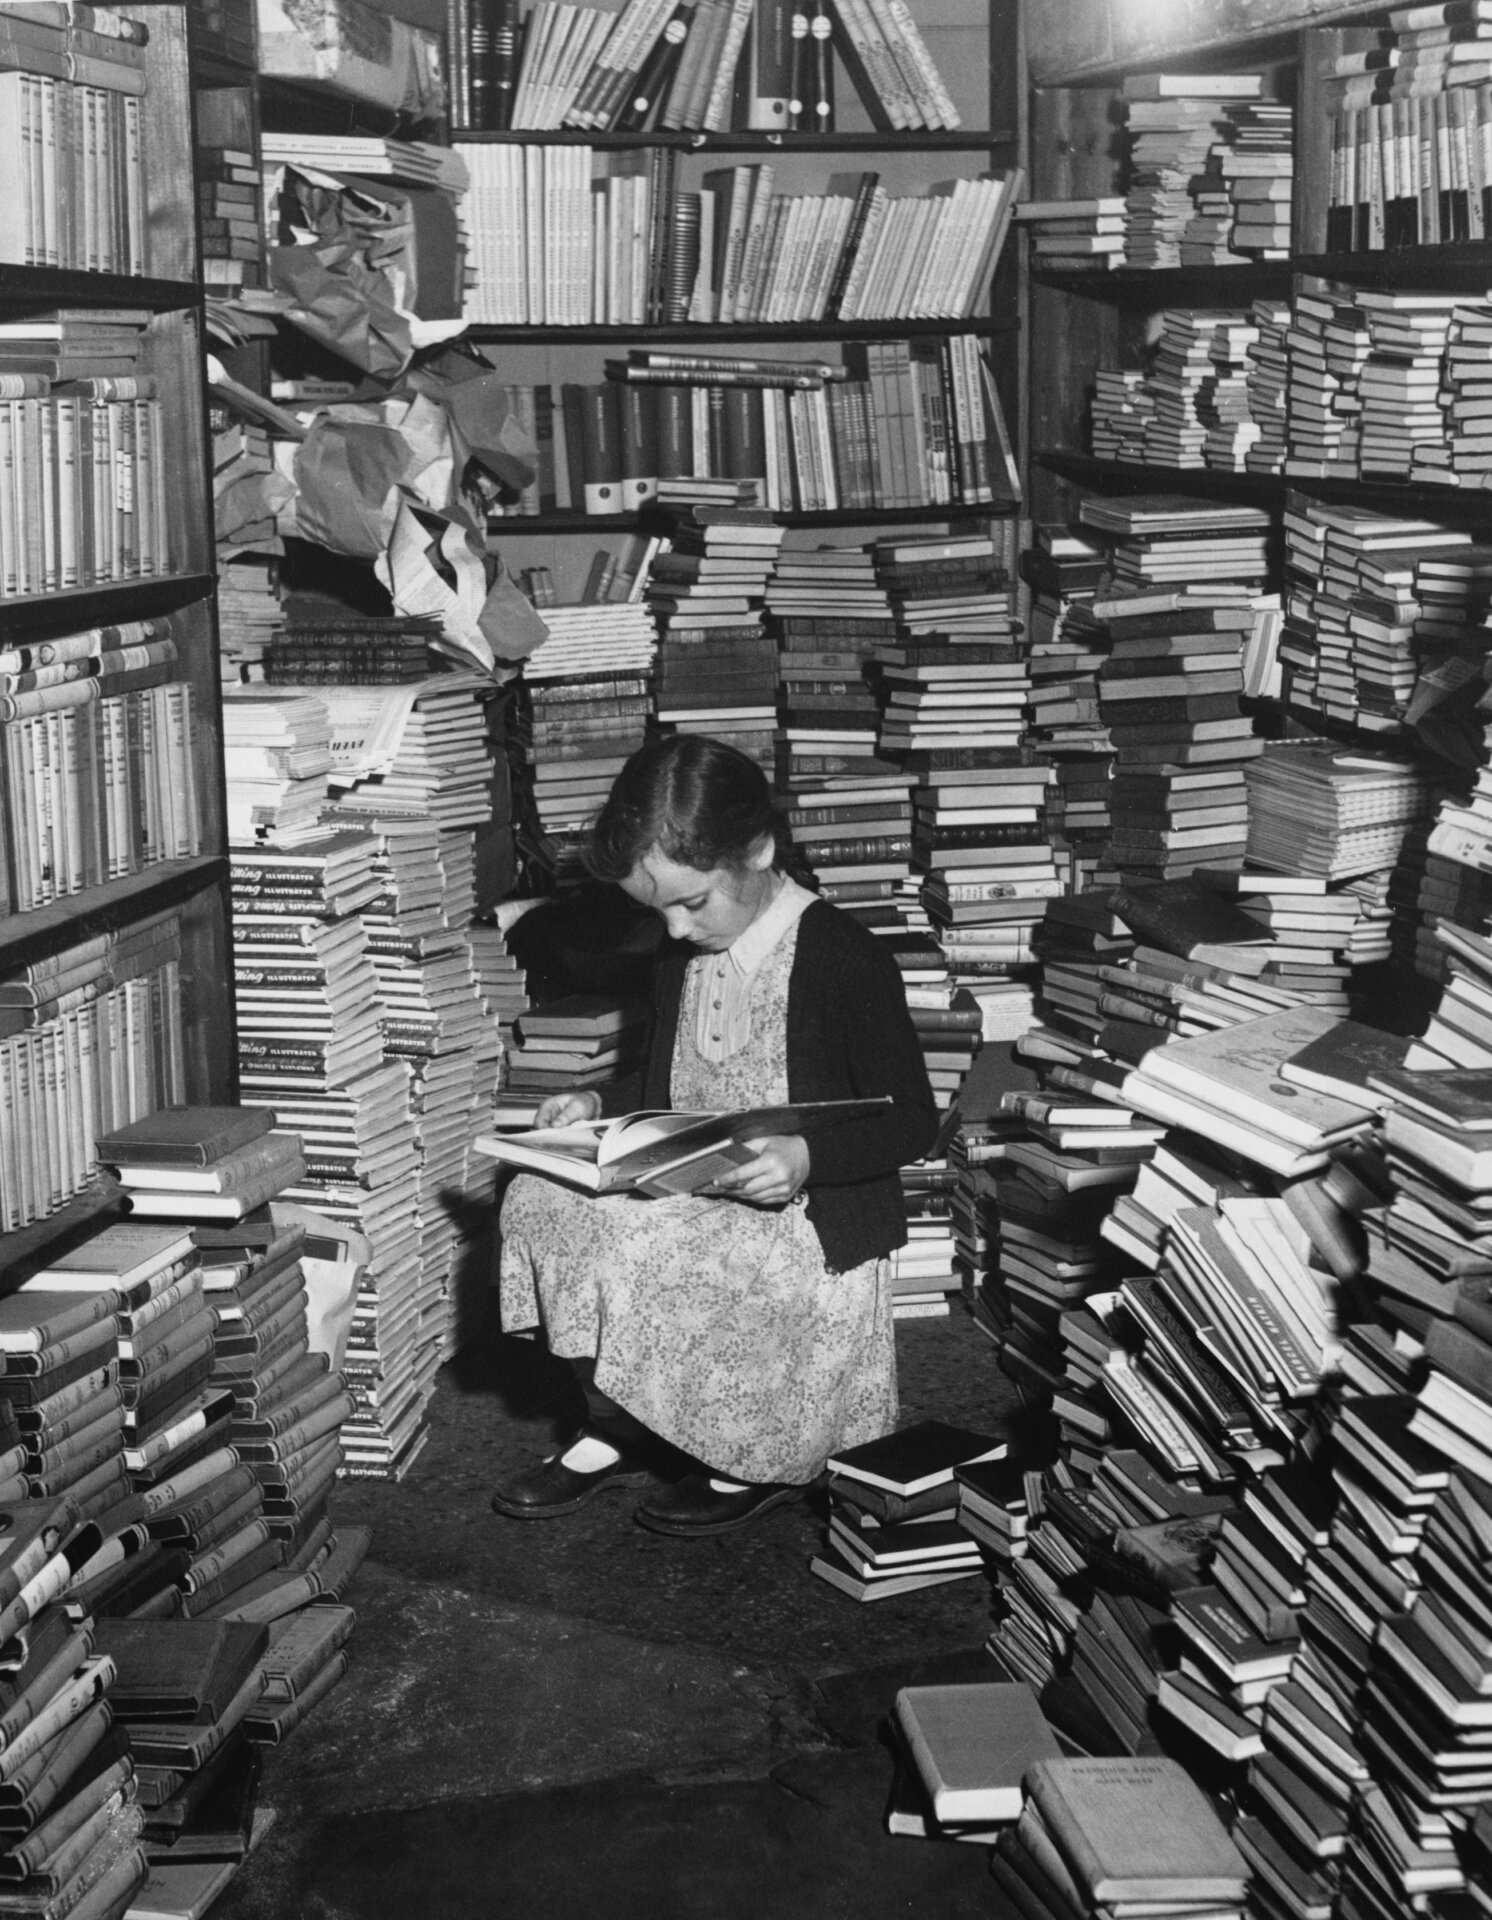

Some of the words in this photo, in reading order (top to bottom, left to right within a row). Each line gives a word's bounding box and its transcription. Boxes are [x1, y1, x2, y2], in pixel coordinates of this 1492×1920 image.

[231, 866, 263, 881] itting
[265, 872, 314, 881] ILLUSTRATED
[264, 887, 313, 895] ILLUSTRATED
[288, 903, 327, 911] COMPLETE
[249, 932, 299, 940] ILLUSTRATED
[266, 974, 317, 982] ILLUSTRATED
[386, 1023, 433, 1031] ILLUSTRATED
[269, 1048, 318, 1057] ILLUSTRATED
[307, 1164, 347, 1172] LUSTRATED
[1278, 1339, 1312, 1380] MARCEL
[349, 1468, 388, 1477] COMPLETE
